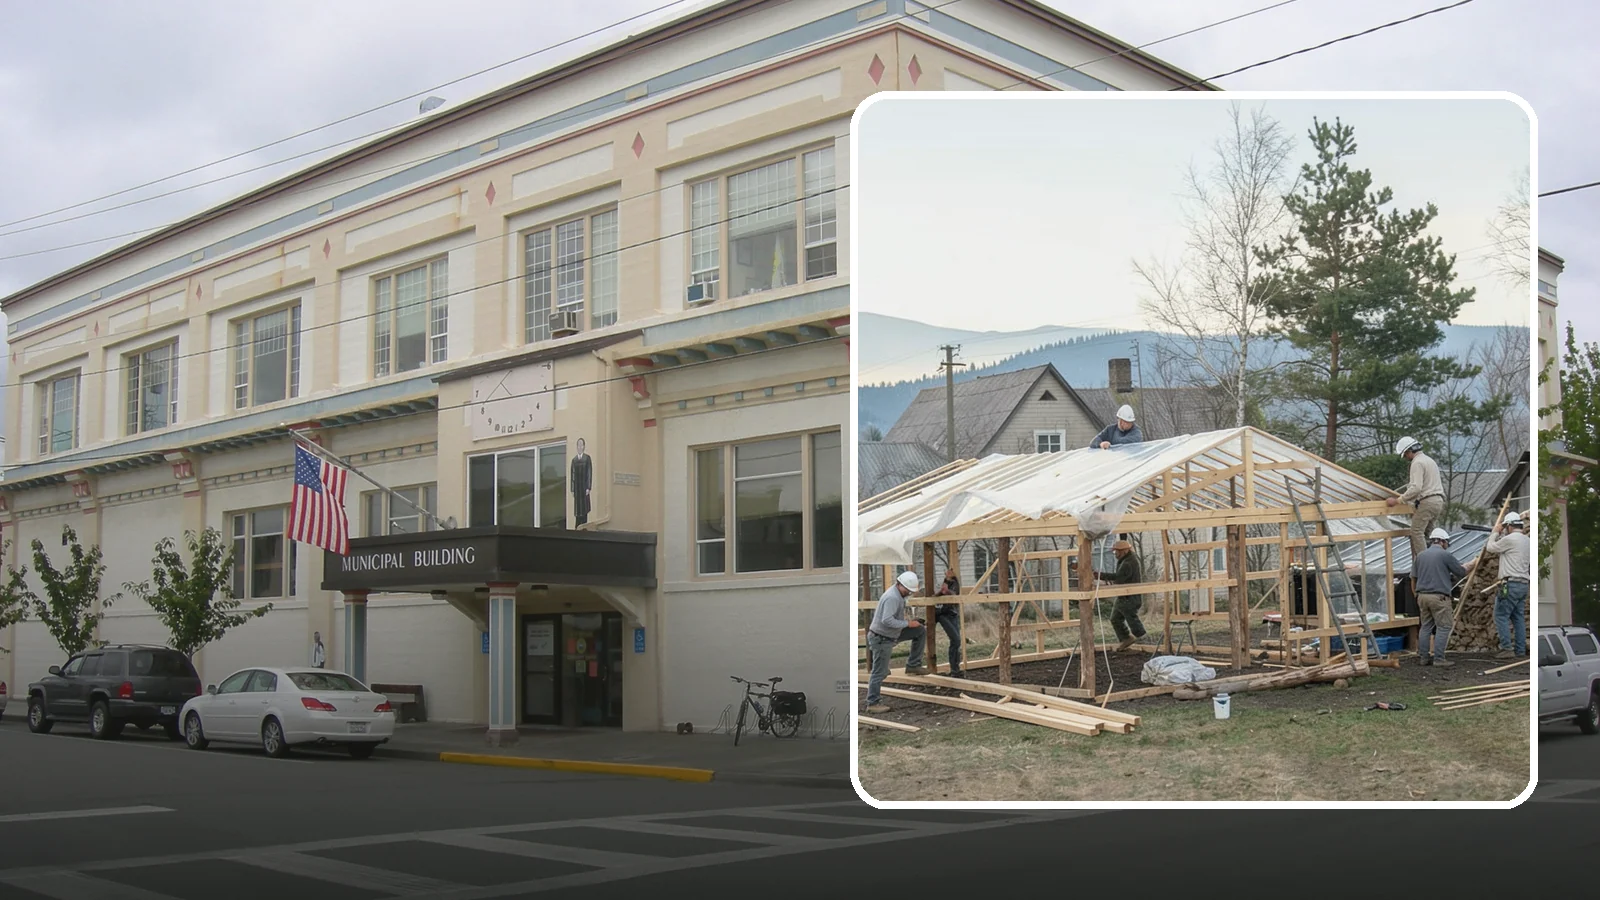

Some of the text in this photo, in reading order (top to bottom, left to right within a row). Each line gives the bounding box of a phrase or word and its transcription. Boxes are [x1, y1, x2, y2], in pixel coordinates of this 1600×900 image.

[536, 402, 540, 410] 4
[481, 407, 485, 415] 8
[488, 417, 492, 425] 9
[529, 414, 533, 422] 3
[508, 425, 513, 433] 12
[521, 420, 525, 428] 2
[342, 546, 475, 572] MUNICIPAL BUILDING
